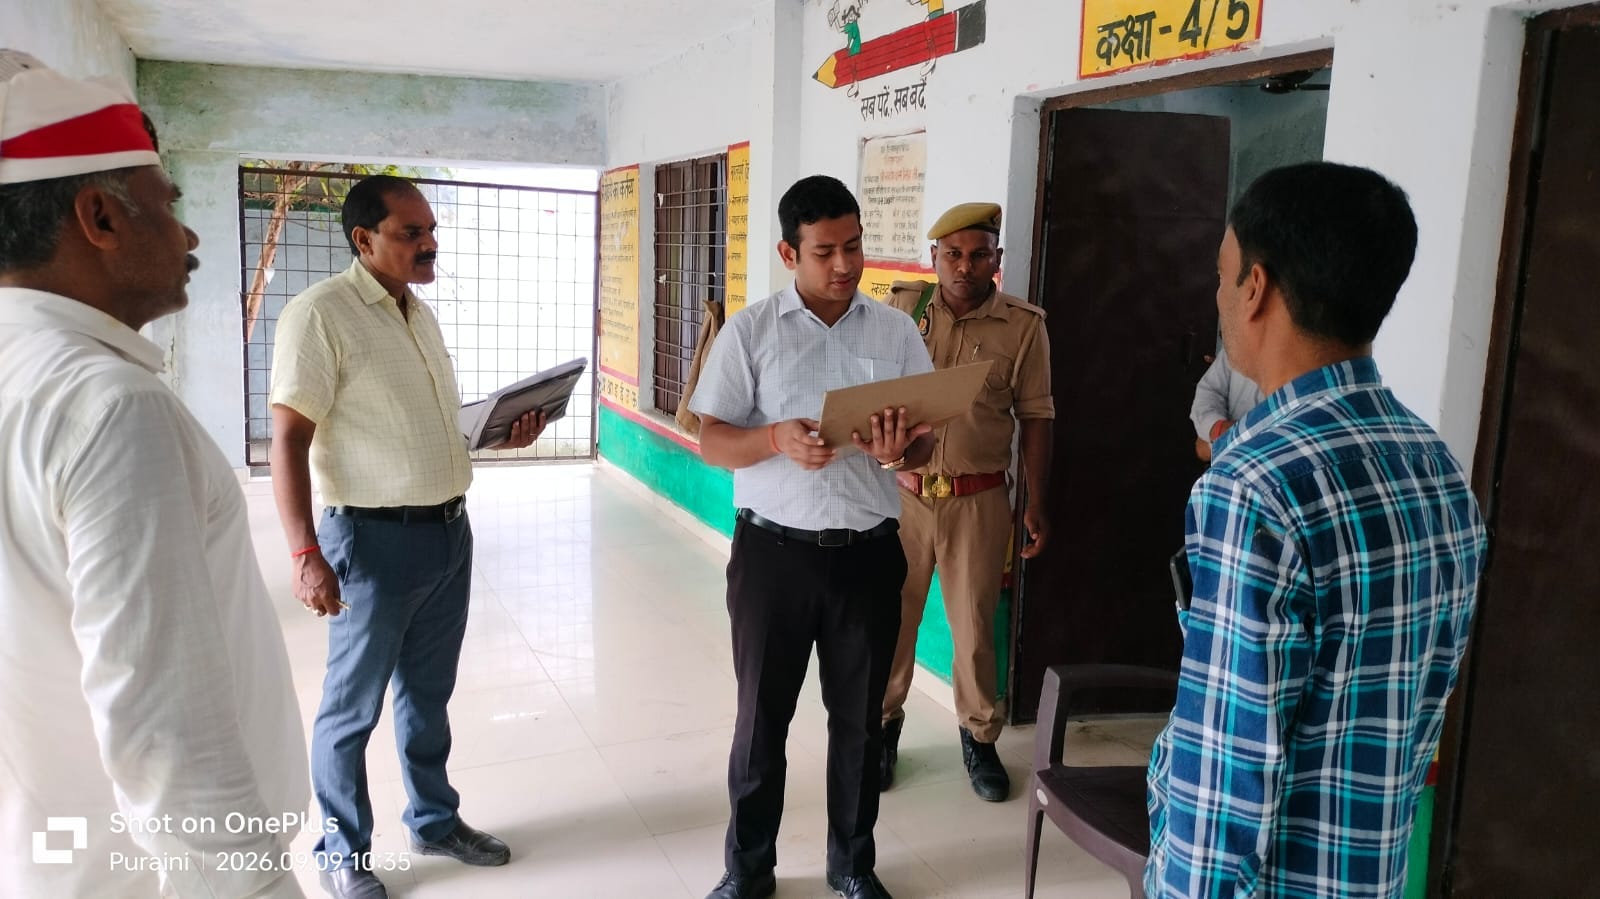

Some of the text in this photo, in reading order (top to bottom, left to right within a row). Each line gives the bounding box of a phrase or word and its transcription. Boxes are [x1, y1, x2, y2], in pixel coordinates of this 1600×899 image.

[1096, 10, 1157, 66] कक्षा
[1178, 0, 1250, 48] 4/5
[861, 95, 876, 121] सब
[894, 86, 909, 115] सब
